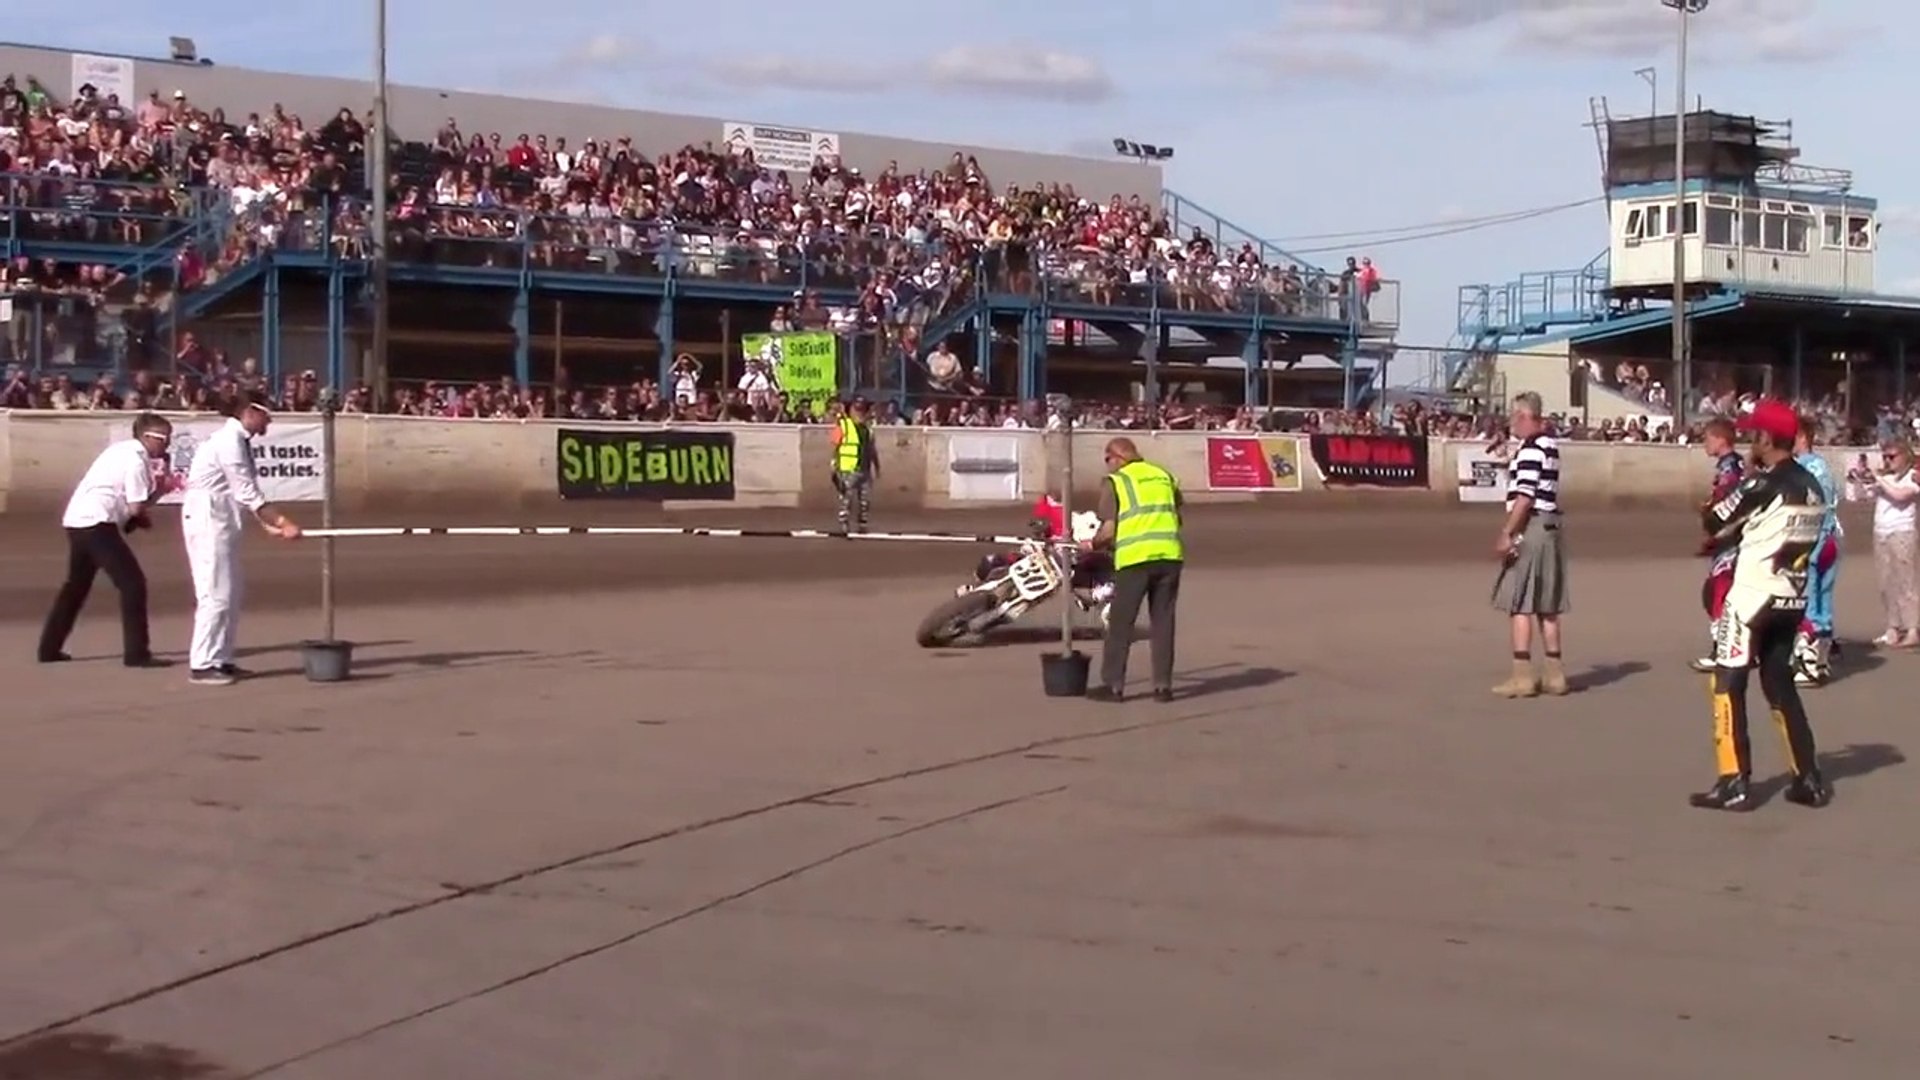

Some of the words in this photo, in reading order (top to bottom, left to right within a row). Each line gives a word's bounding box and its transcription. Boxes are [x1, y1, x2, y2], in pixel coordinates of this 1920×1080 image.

[270, 445, 319, 458] taste.
[561, 437, 730, 484] SIDEBURN
[259, 463, 320, 477] orkies.
